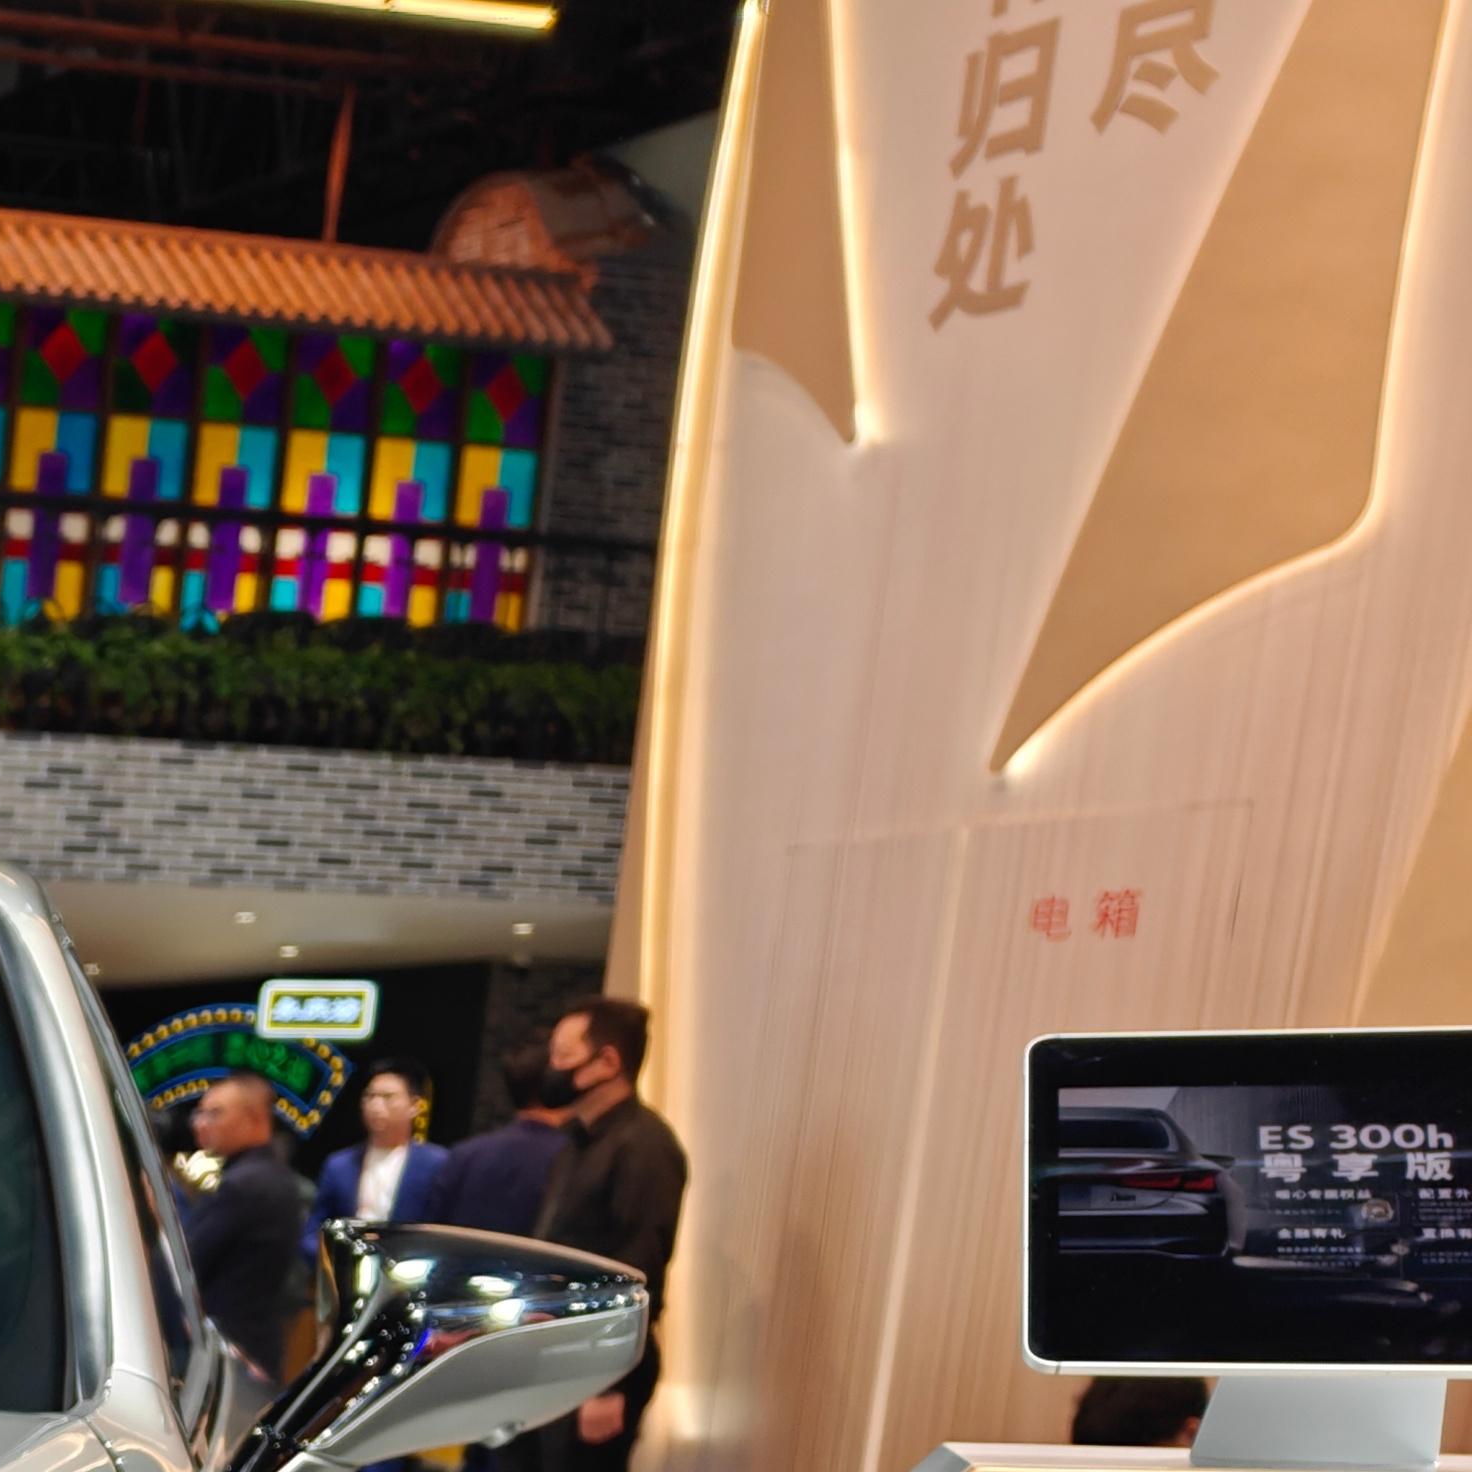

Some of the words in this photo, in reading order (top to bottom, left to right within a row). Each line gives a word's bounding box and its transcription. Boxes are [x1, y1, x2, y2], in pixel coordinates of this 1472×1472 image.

[927, 0, 1063, 334] 归处
[1029, 889, 1142, 941] 电箱
[1258, 1124, 1315, 1150] ES
[1329, 1123, 1454, 1150] 300h
[1259, 1151, 1455, 1183] 粤享版
